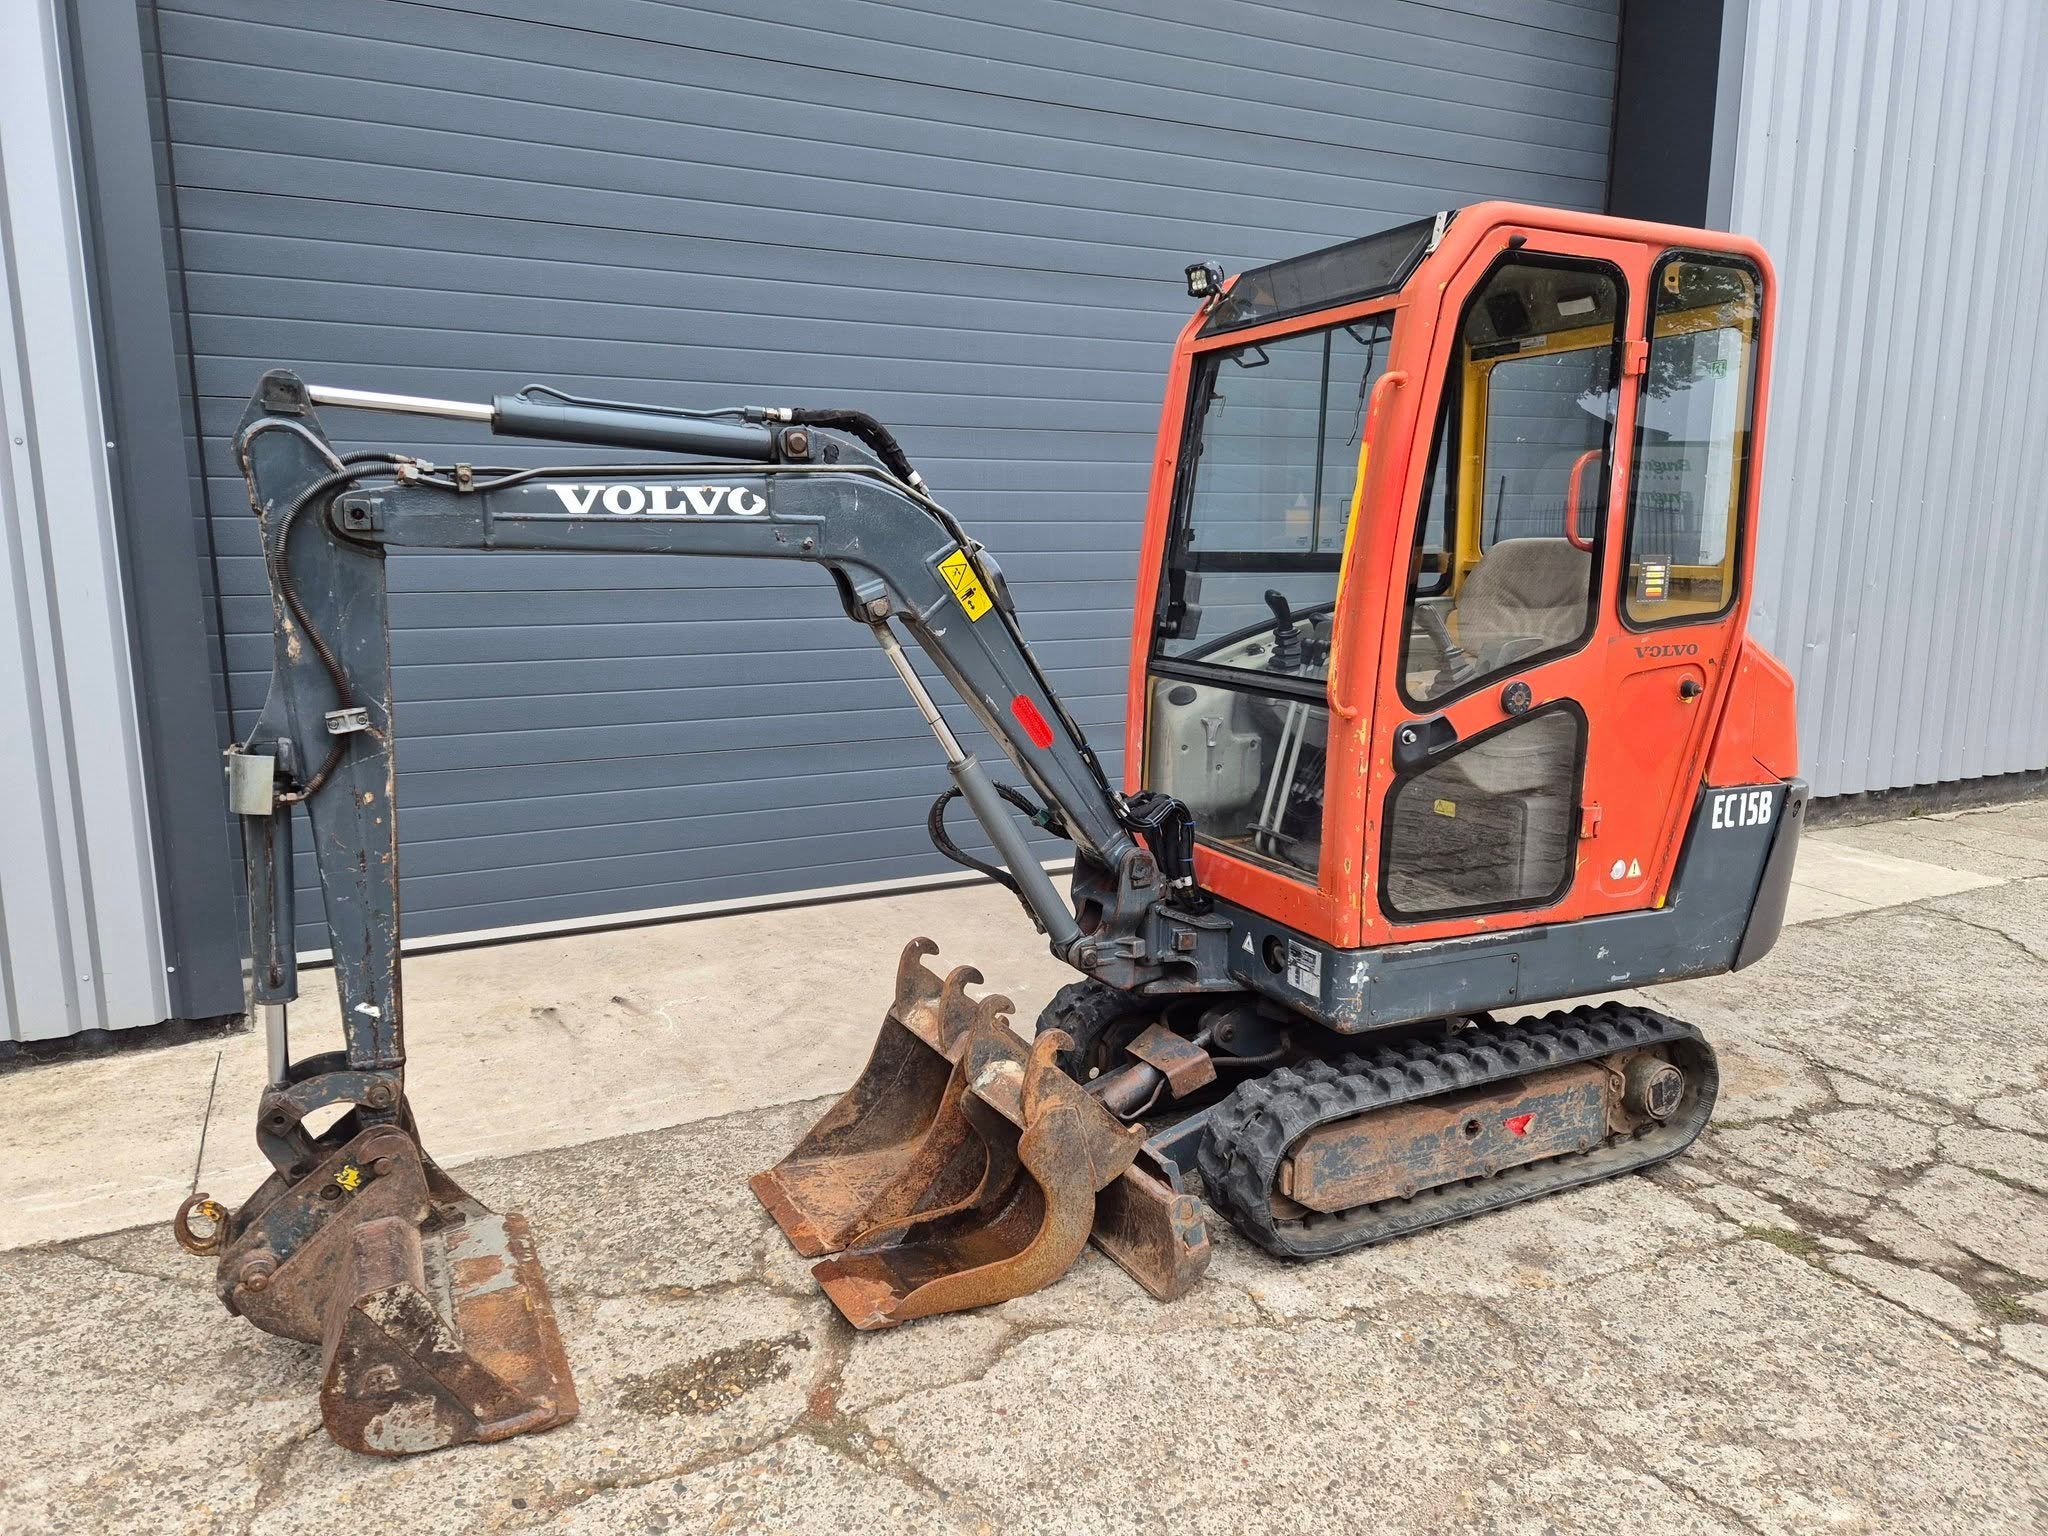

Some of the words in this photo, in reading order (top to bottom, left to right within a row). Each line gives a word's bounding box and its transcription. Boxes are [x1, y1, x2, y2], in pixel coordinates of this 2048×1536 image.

[547, 484, 766, 515] VOLVO
[1634, 643, 1699, 659] VOLVO
[1712, 791, 1772, 829] EC15B
